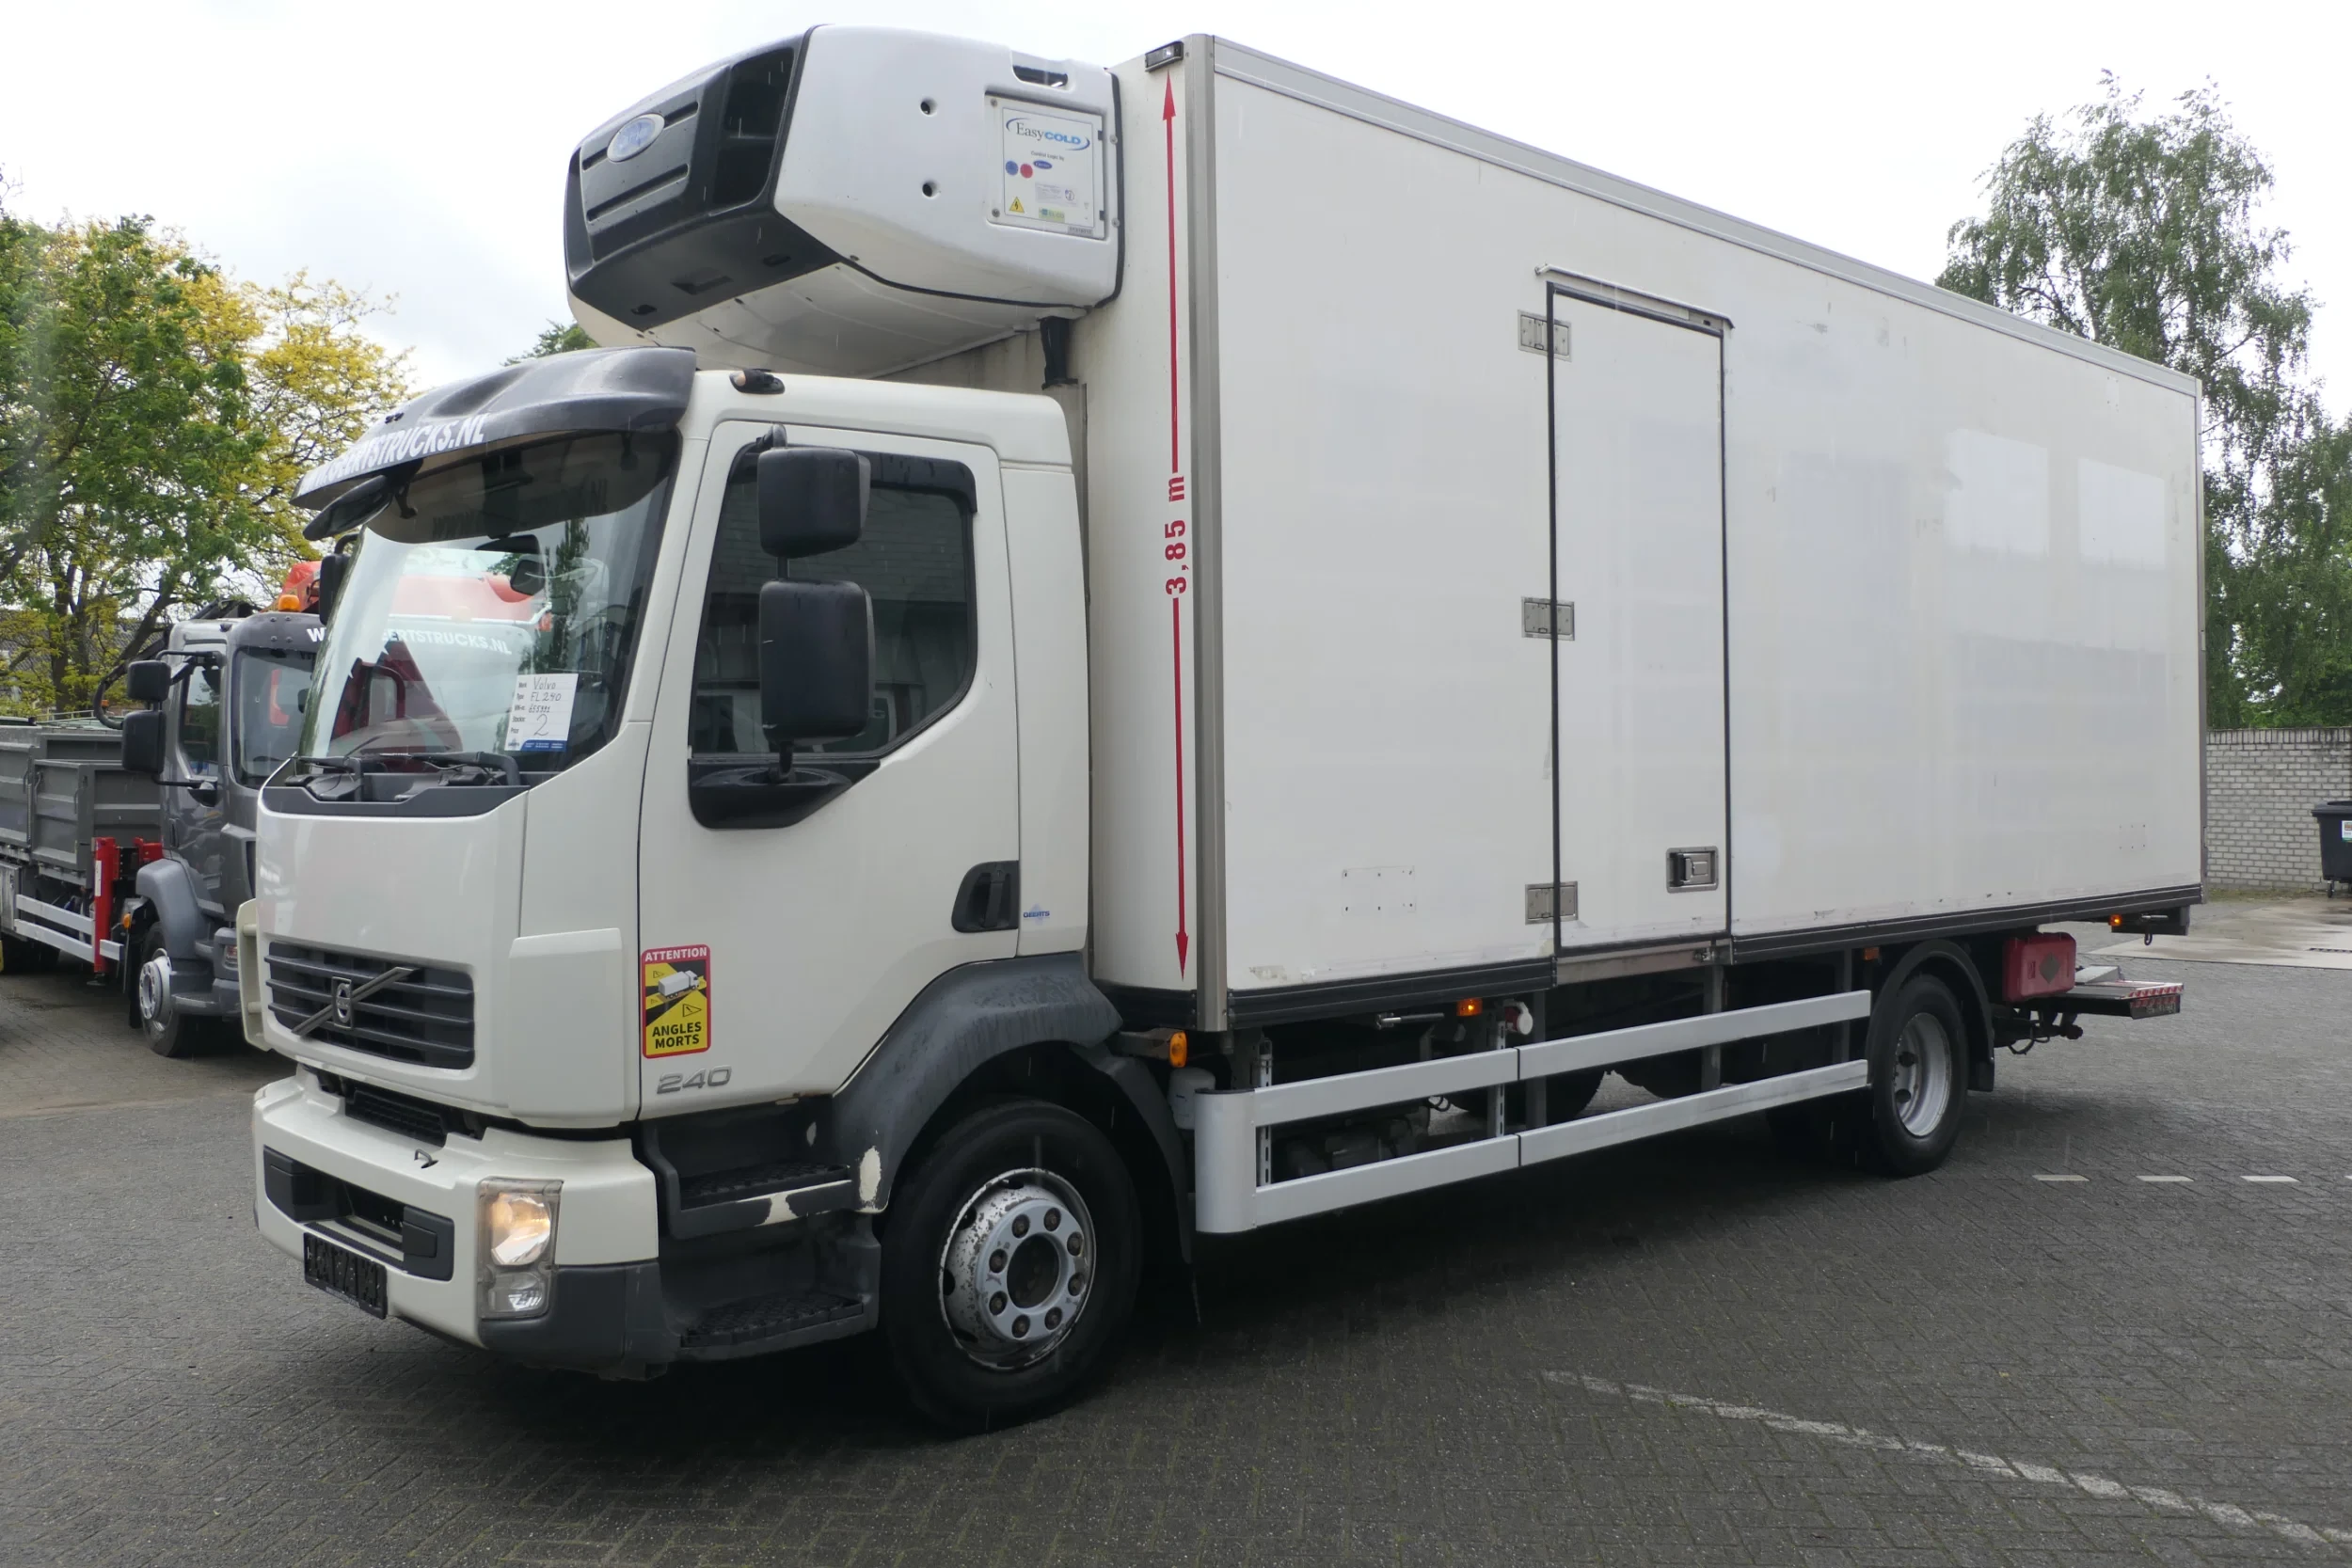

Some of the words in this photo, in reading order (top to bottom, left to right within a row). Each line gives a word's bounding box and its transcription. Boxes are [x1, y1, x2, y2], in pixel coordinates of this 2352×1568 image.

[1016, 121, 1081, 145] EasyCOLD
[1168, 476, 1184, 502] m
[1165, 520, 1189, 594] 3,85
[533, 676, 557, 690] Volvo
[531, 691, 539, 702] FL
[542, 691, 562, 702] 240
[533, 713, 549, 736] 2
[644, 946, 707, 962] ATTENTION
[652, 1022, 702, 1037] ANGLES
[655, 1034, 700, 1050] MORTS
[657, 1064, 732, 1095] 240
